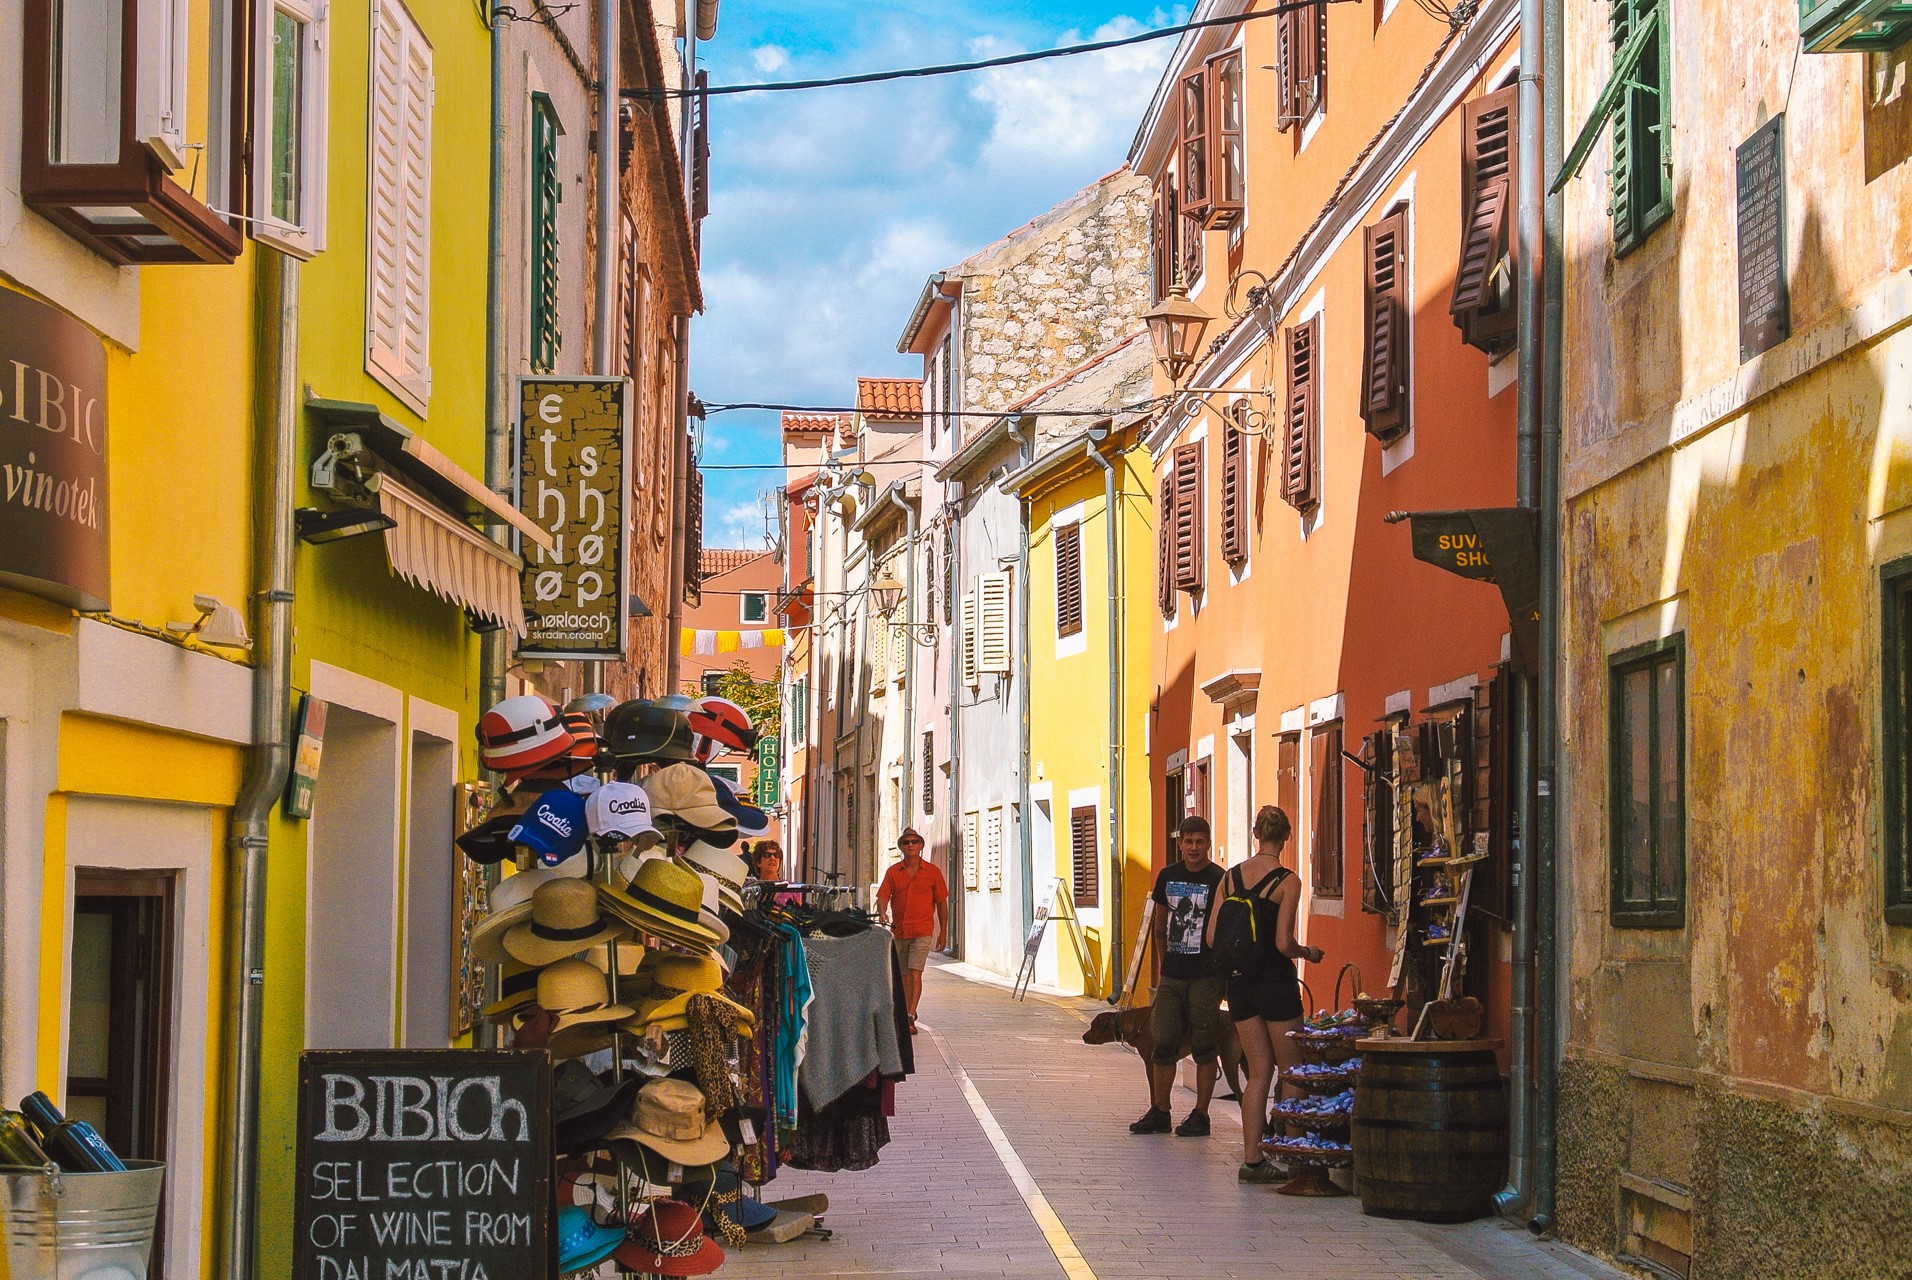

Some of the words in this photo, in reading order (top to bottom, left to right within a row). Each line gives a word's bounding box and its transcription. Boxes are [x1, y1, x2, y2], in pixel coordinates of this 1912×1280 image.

[3, 451, 103, 532] vinotek
[1439, 534, 1483, 549] SUV
[532, 630, 604, 640] skradin.croatia
[763, 743, 776, 805] HOTEL
[537, 804, 572, 837] Croatia
[609, 797, 646, 814] Croatia
[311, 1158, 519, 1202] SELECTION
[309, 1214, 357, 1248] OF
[370, 1210, 452, 1247] WINE
[465, 1210, 531, 1247] FROM
